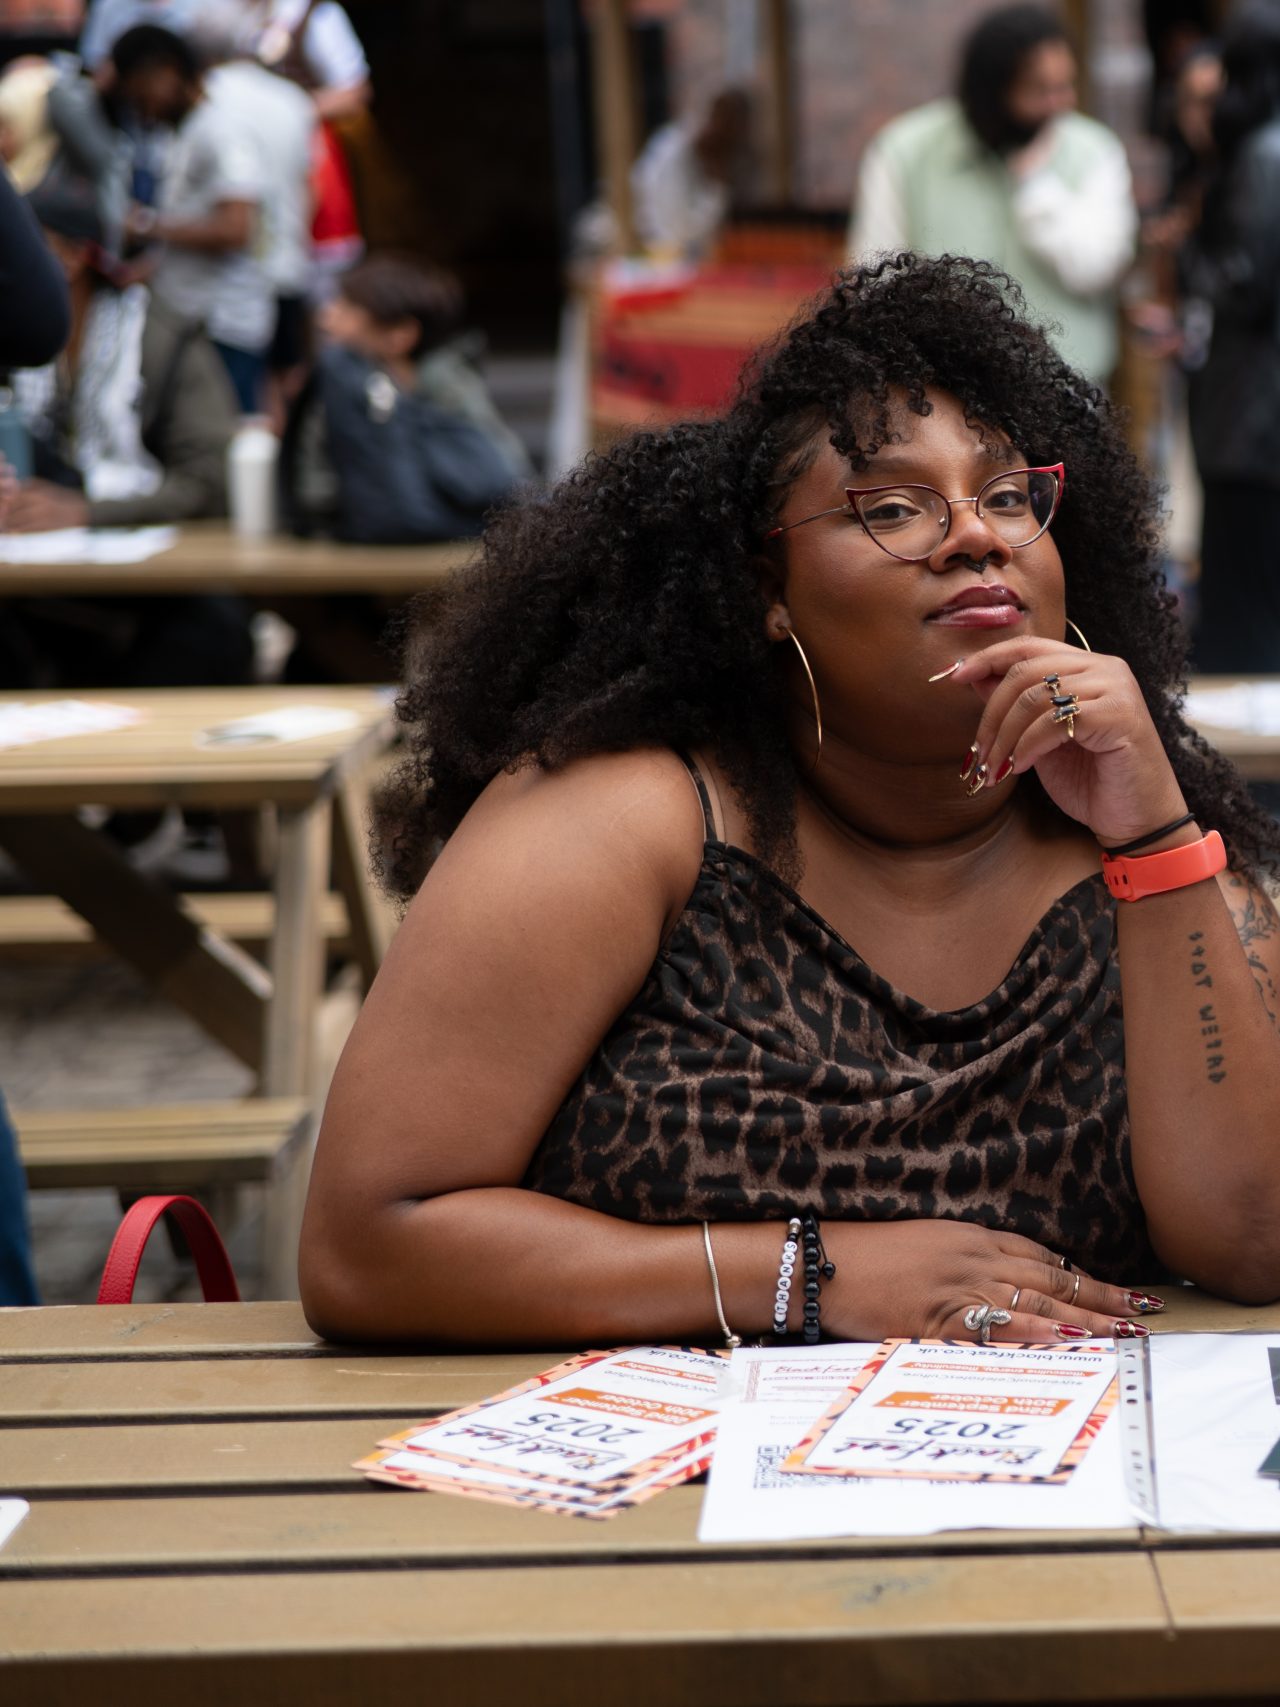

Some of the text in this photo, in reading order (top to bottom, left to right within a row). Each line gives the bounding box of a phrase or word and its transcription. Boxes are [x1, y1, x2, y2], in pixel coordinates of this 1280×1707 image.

[776, 1243, 797, 1311] THANKS
[919, 1347, 1102, 1363] www.blackfest.co.uk
[561, 1397, 646, 1417] September
[597, 1394, 661, 1410] October
[901, 1399, 1002, 1414] September
[929, 1394, 1008, 1404] October
[514, 1413, 645, 1443] 2025
[887, 1418, 1027, 1439] 2025
